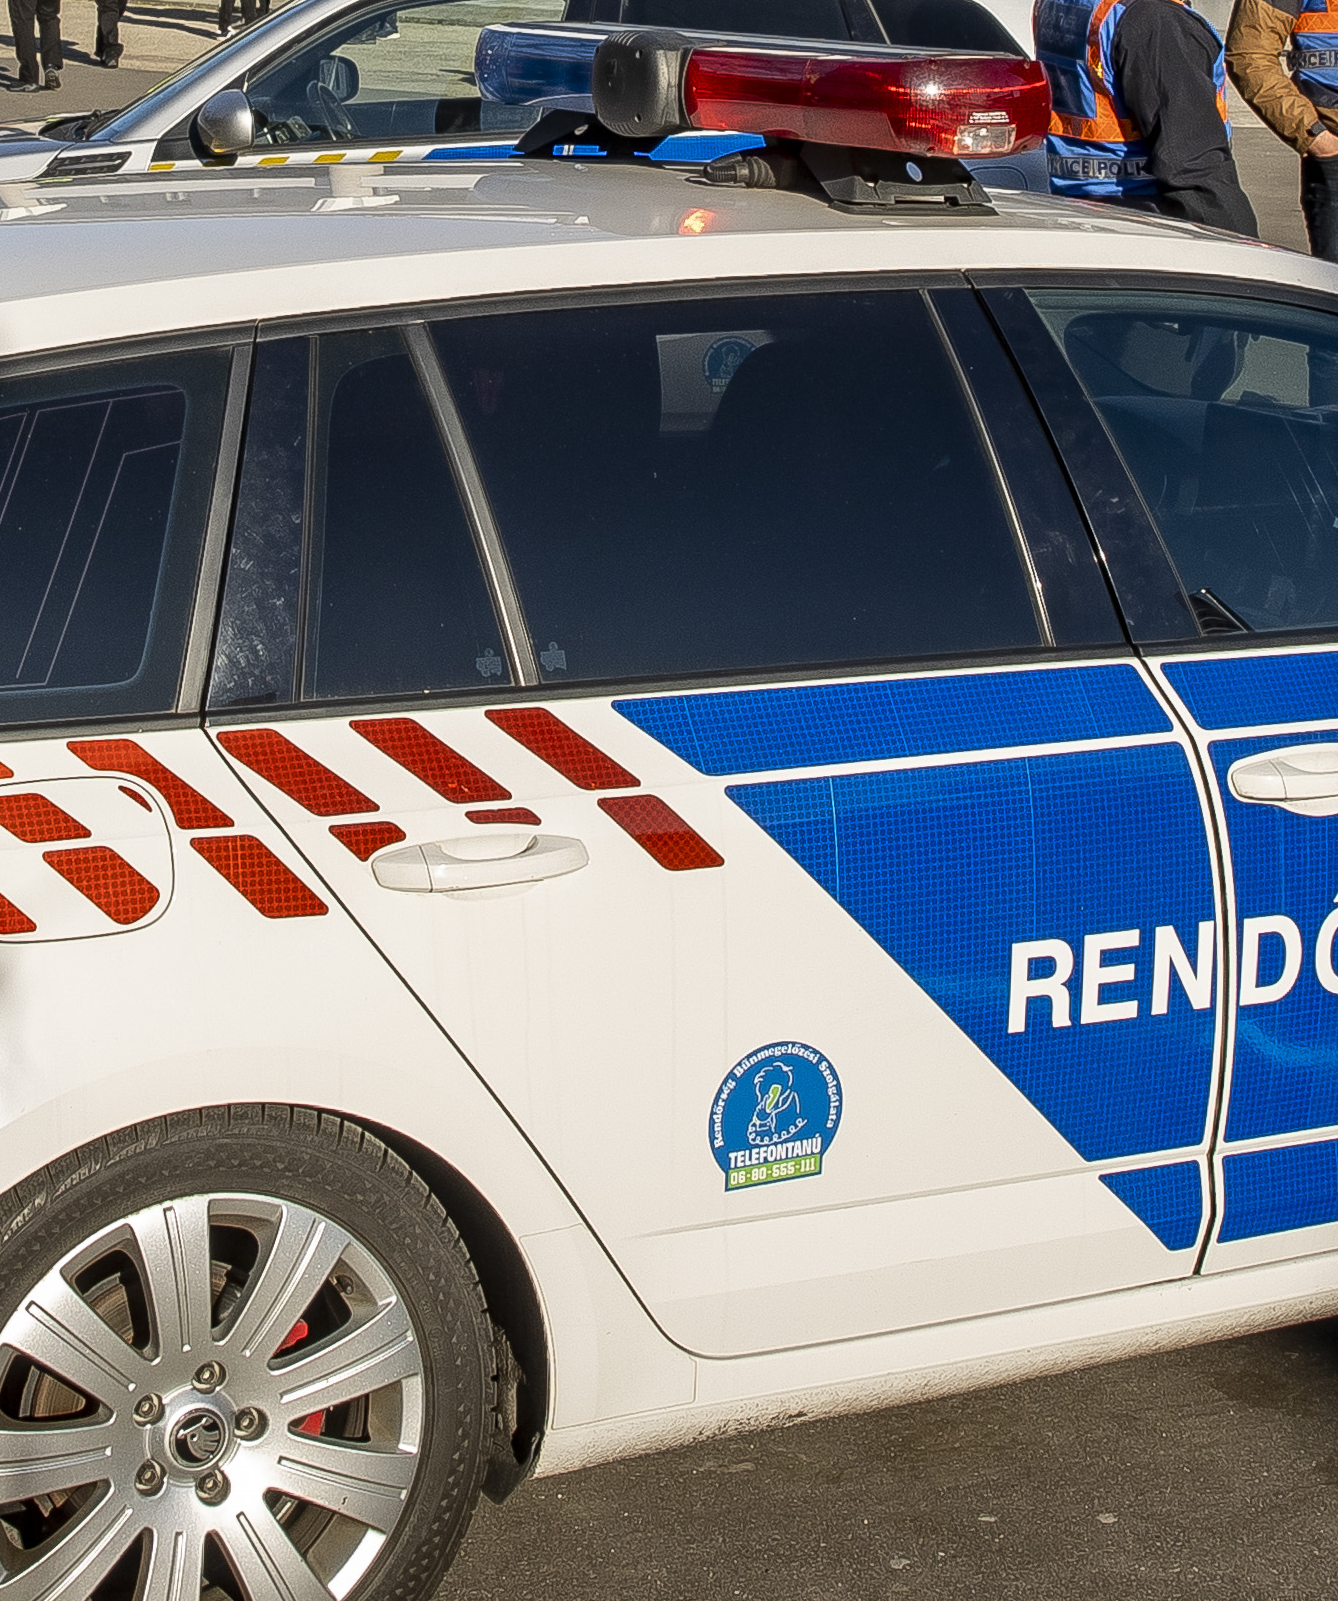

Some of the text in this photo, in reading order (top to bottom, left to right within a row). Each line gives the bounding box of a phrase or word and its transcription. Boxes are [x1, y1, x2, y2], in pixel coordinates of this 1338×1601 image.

[1097, 160, 1144, 176] POLI
[819, 1061, 840, 1128] Szolgálata
[728, 1133, 822, 1169] TELEFONTANÚ
